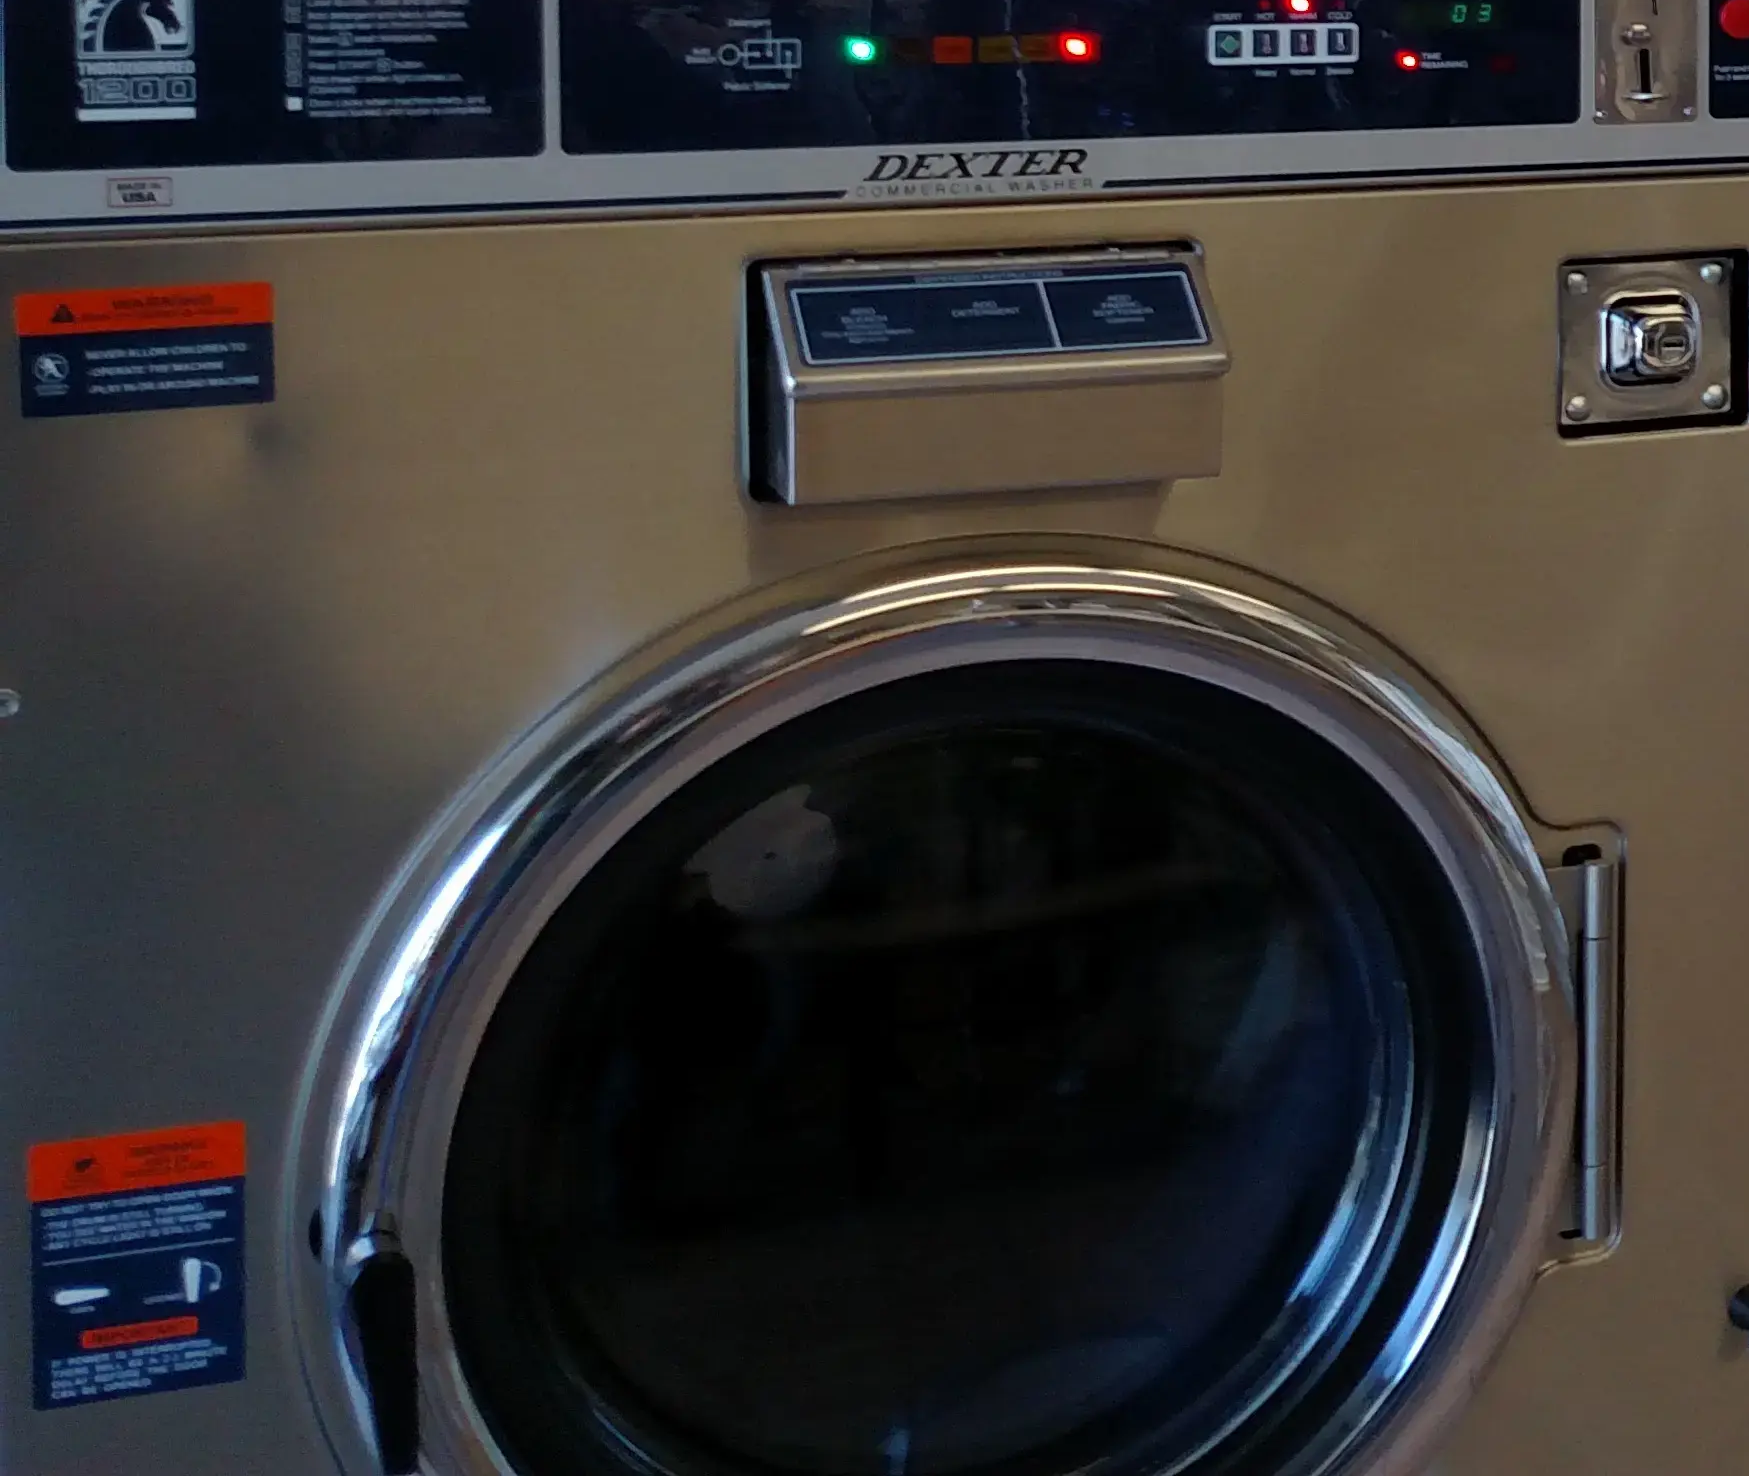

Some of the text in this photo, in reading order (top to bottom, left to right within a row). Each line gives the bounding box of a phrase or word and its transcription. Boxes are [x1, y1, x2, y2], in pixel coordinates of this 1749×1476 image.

[78, 75, 197, 104] 1200
[863, 148, 1088, 182] DEXTER
[856, 178, 1094, 198] COMMERCIAL WASHER
